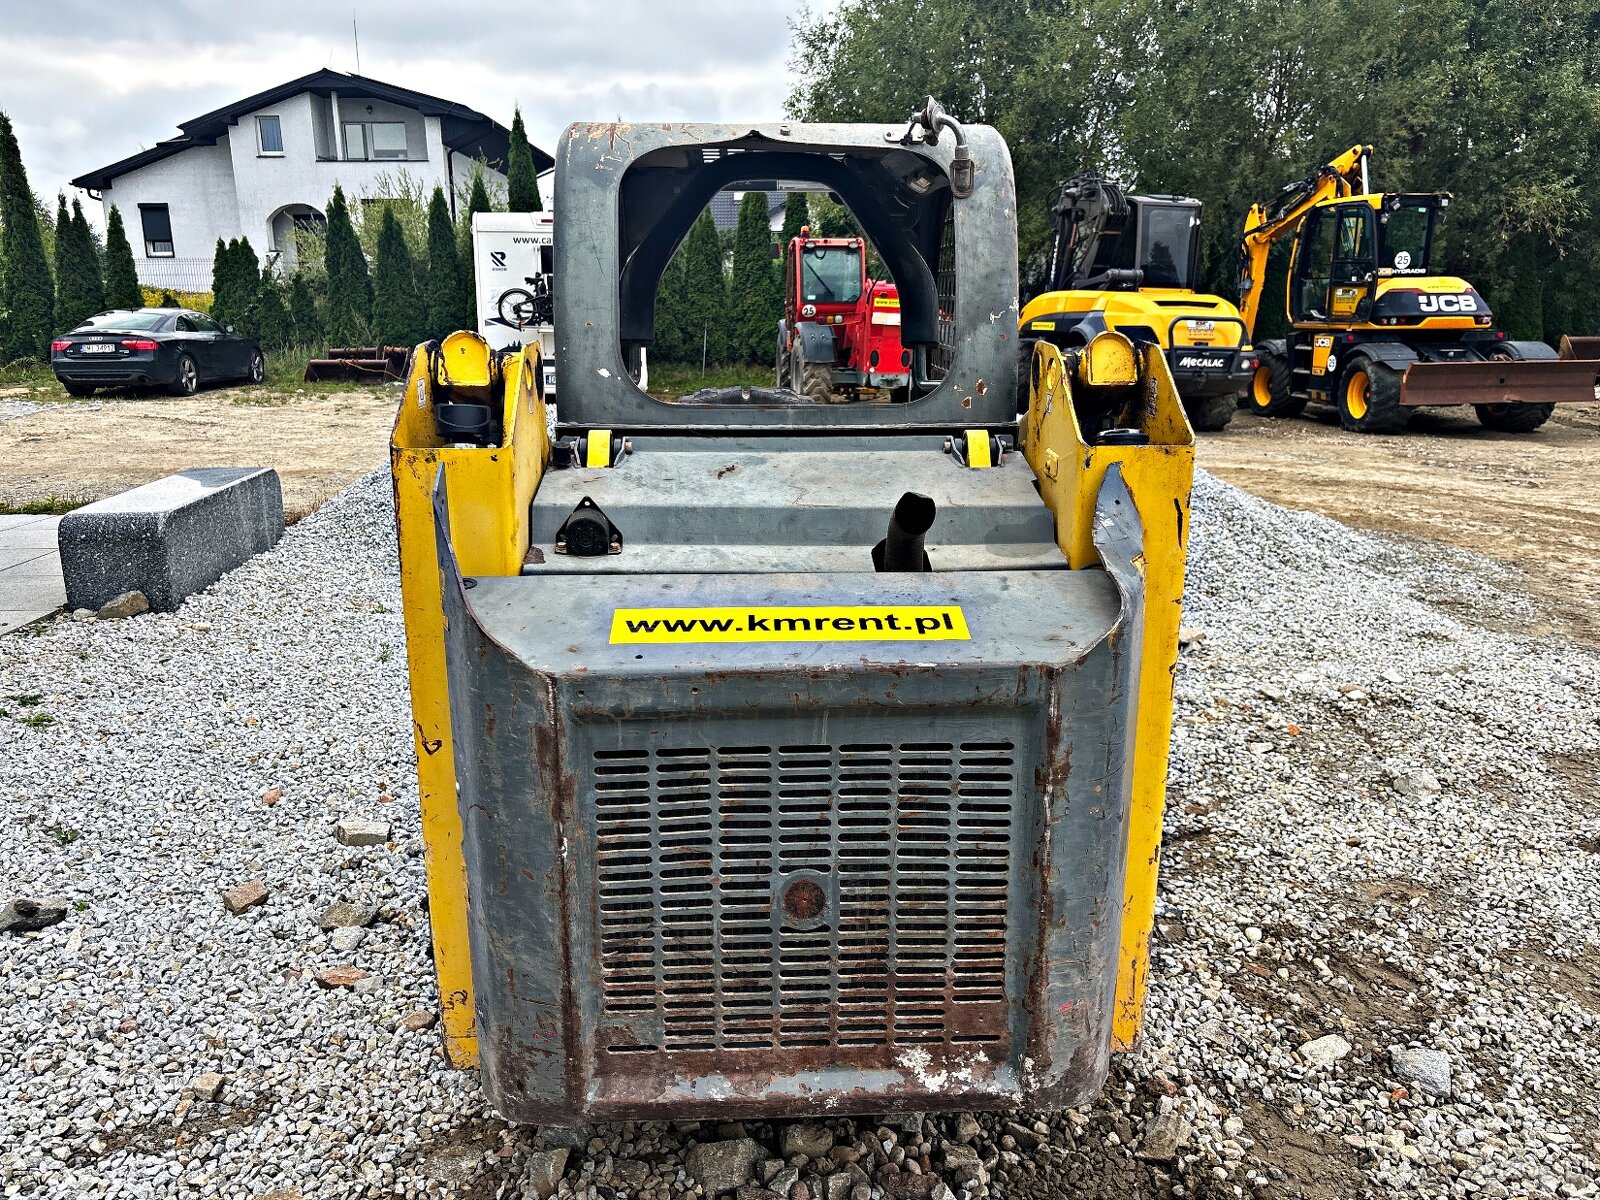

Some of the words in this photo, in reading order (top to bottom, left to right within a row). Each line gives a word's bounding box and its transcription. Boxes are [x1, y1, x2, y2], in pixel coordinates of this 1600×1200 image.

[1396, 255, 1409, 265] 25
[1418, 295, 1478, 312] JCB
[625, 612, 954, 634] www.kmrent.pl
